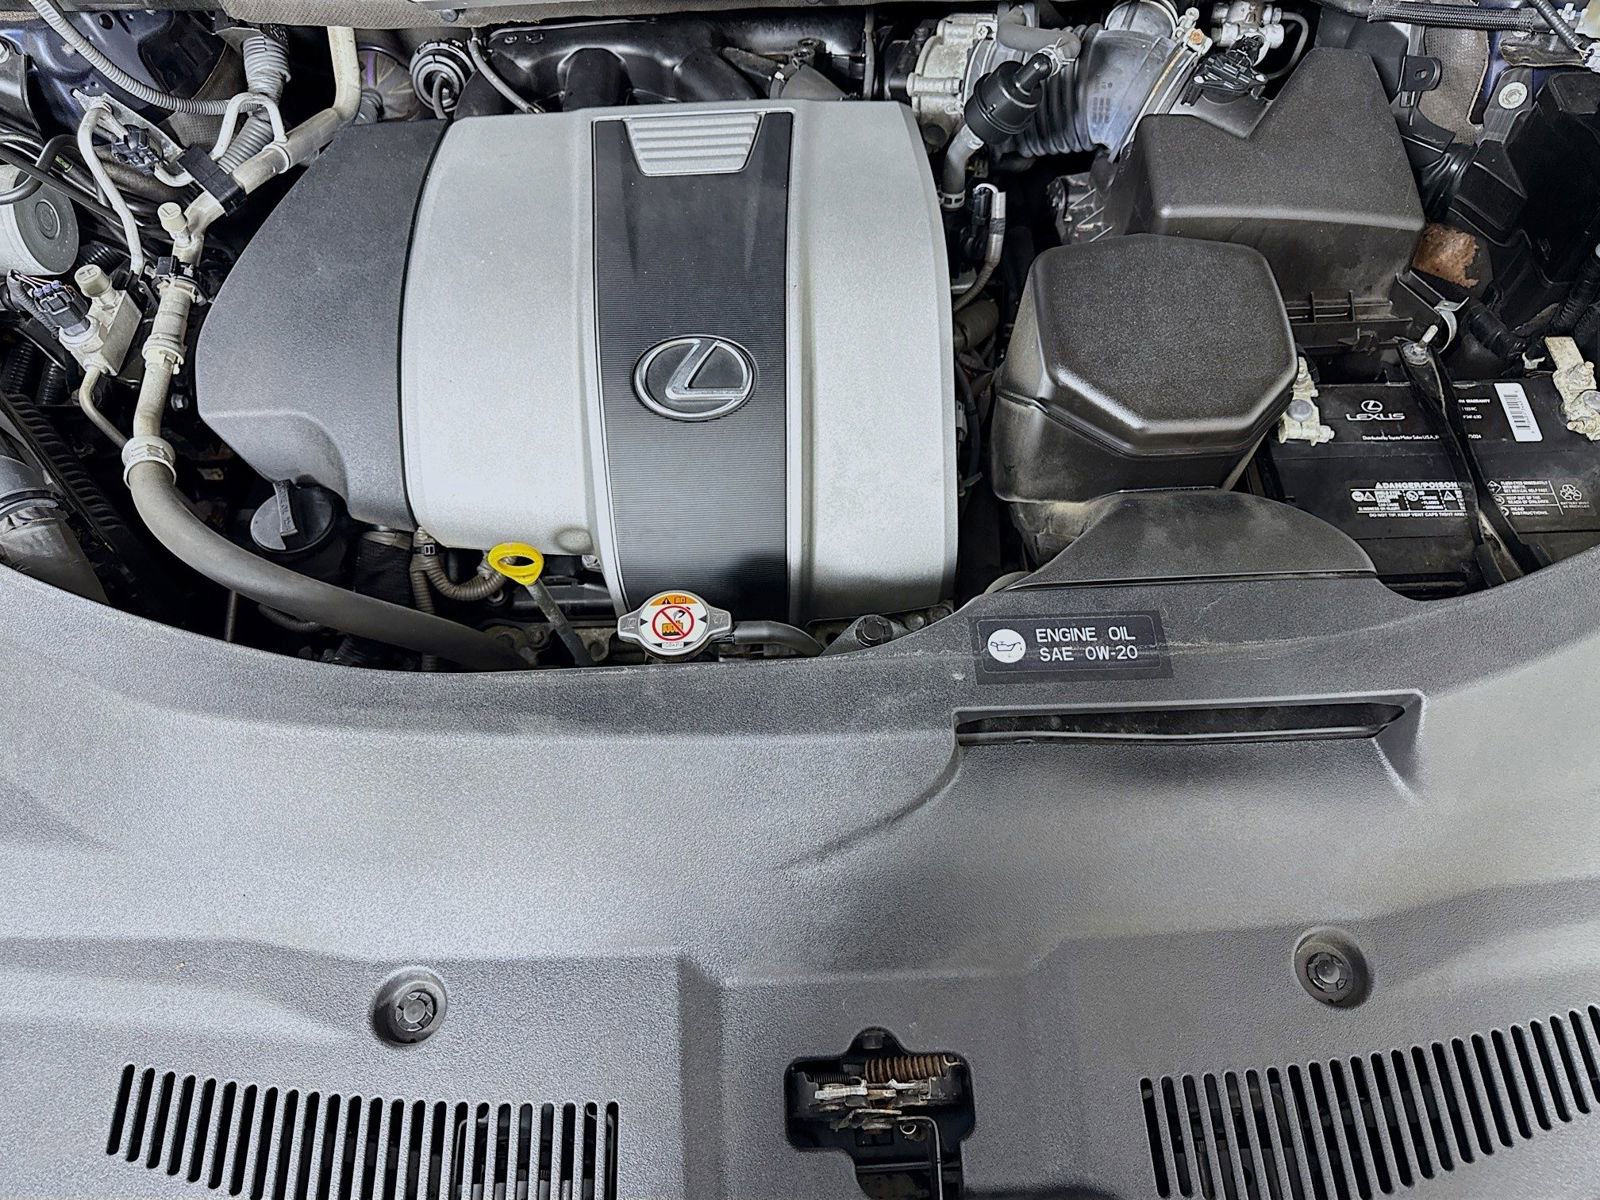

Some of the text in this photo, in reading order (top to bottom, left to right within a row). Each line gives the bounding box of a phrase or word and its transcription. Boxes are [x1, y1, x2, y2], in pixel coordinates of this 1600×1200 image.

[1345, 412, 1406, 421] LEXUS
[1035, 626, 1136, 643] ENGINE OIL
[1039, 645, 1138, 662] SAE 0W-20
